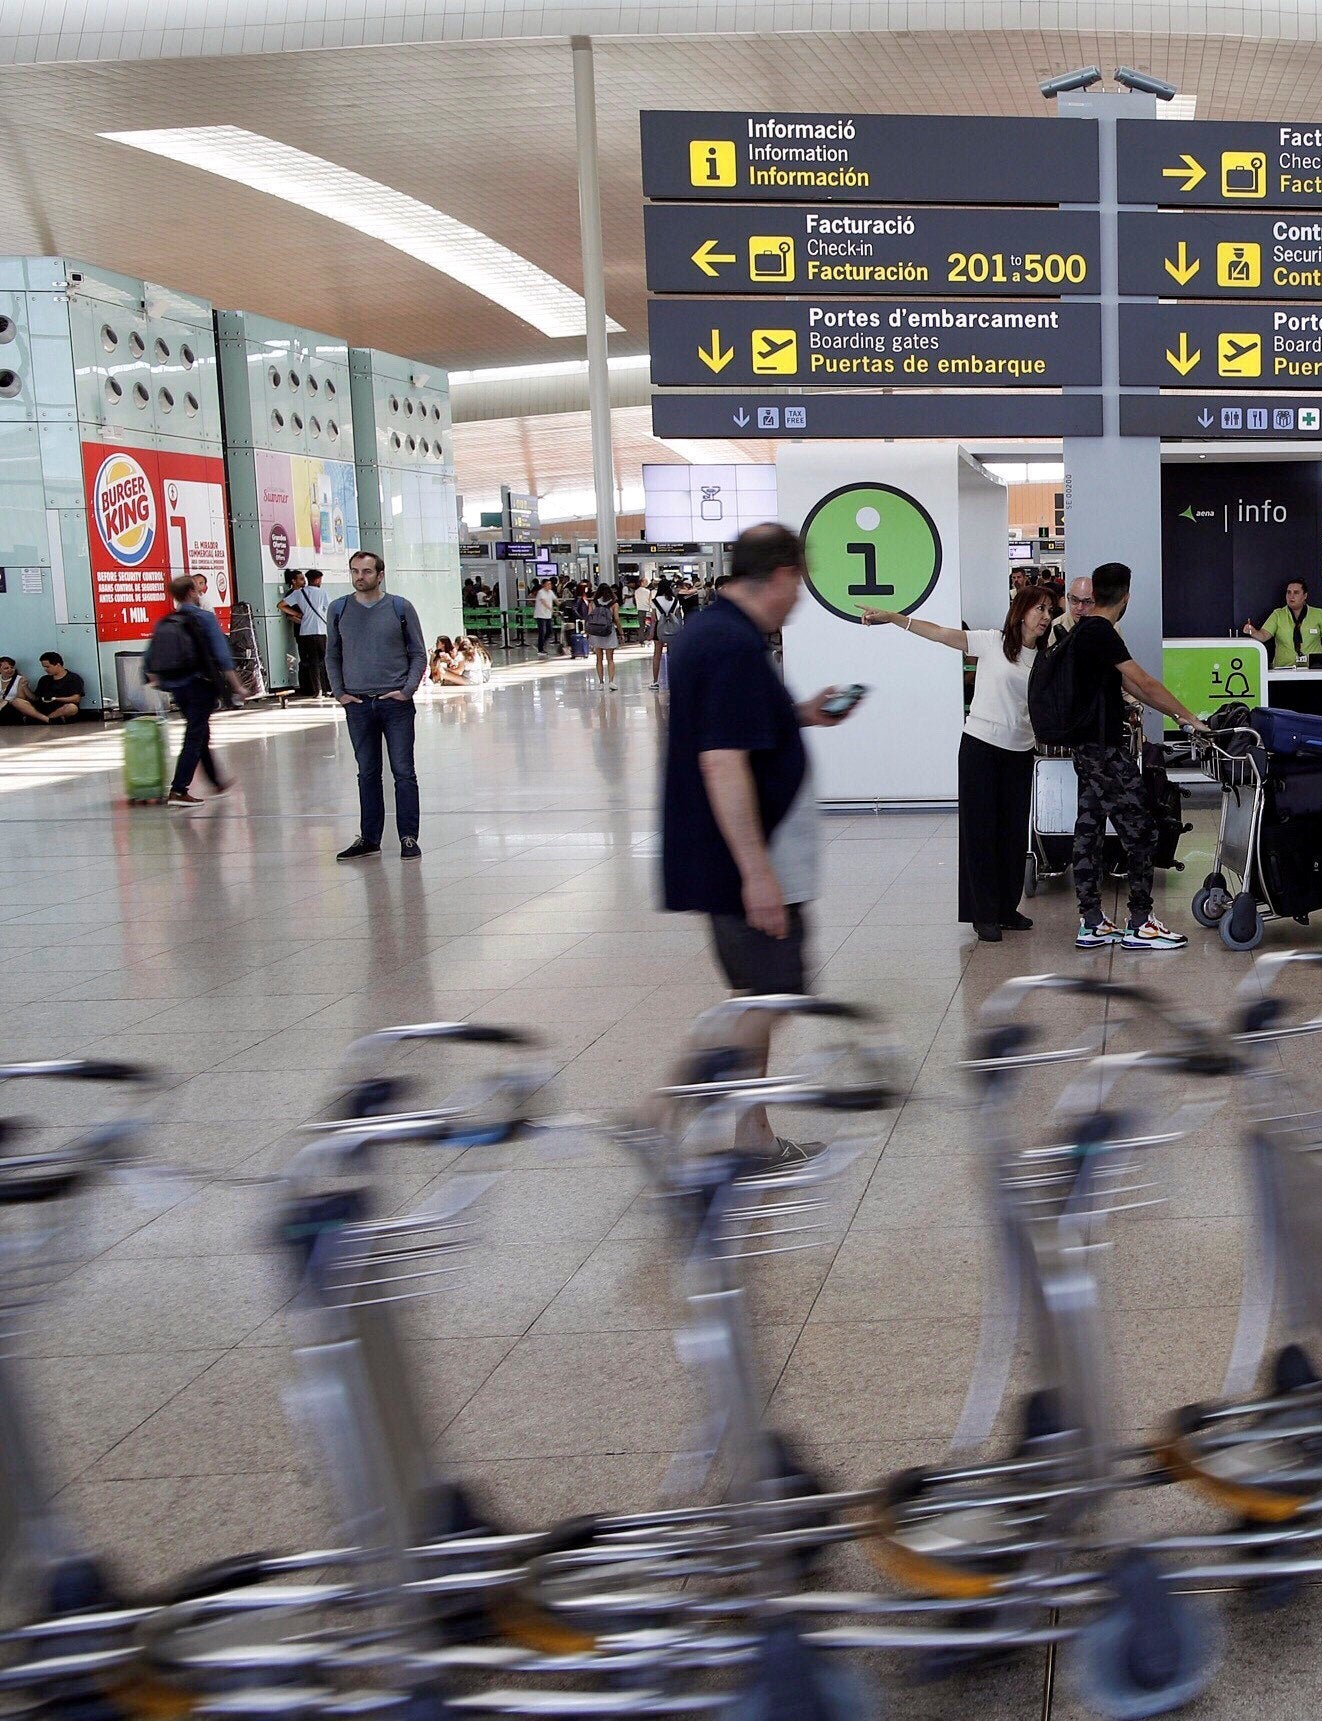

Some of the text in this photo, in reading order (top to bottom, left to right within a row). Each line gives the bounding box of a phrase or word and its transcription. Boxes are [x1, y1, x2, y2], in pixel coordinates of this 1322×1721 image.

[748, 119, 855, 139] Informació
[749, 144, 847, 161] Information
[750, 166, 868, 186] Información
[807, 215, 914, 234] Facturació
[808, 239, 872, 255] Check-in
[808, 253, 1006, 282] Facturación 201
[1025, 254, 1086, 283] 500
[810, 308, 1058, 328] Portes d'embarcament
[810, 332, 938, 352] Boarding gates
[811, 354, 1045, 377] Puertas de embarque
[101, 476, 146, 513] BURGER
[264, 488, 289, 504] Summer
[104, 495, 150, 542] KING
[1239, 499, 1287, 522] info
[97, 571, 164, 581] BEFORE SECURITY CONTROL
[121, 607, 149, 623] 1 MIN.
